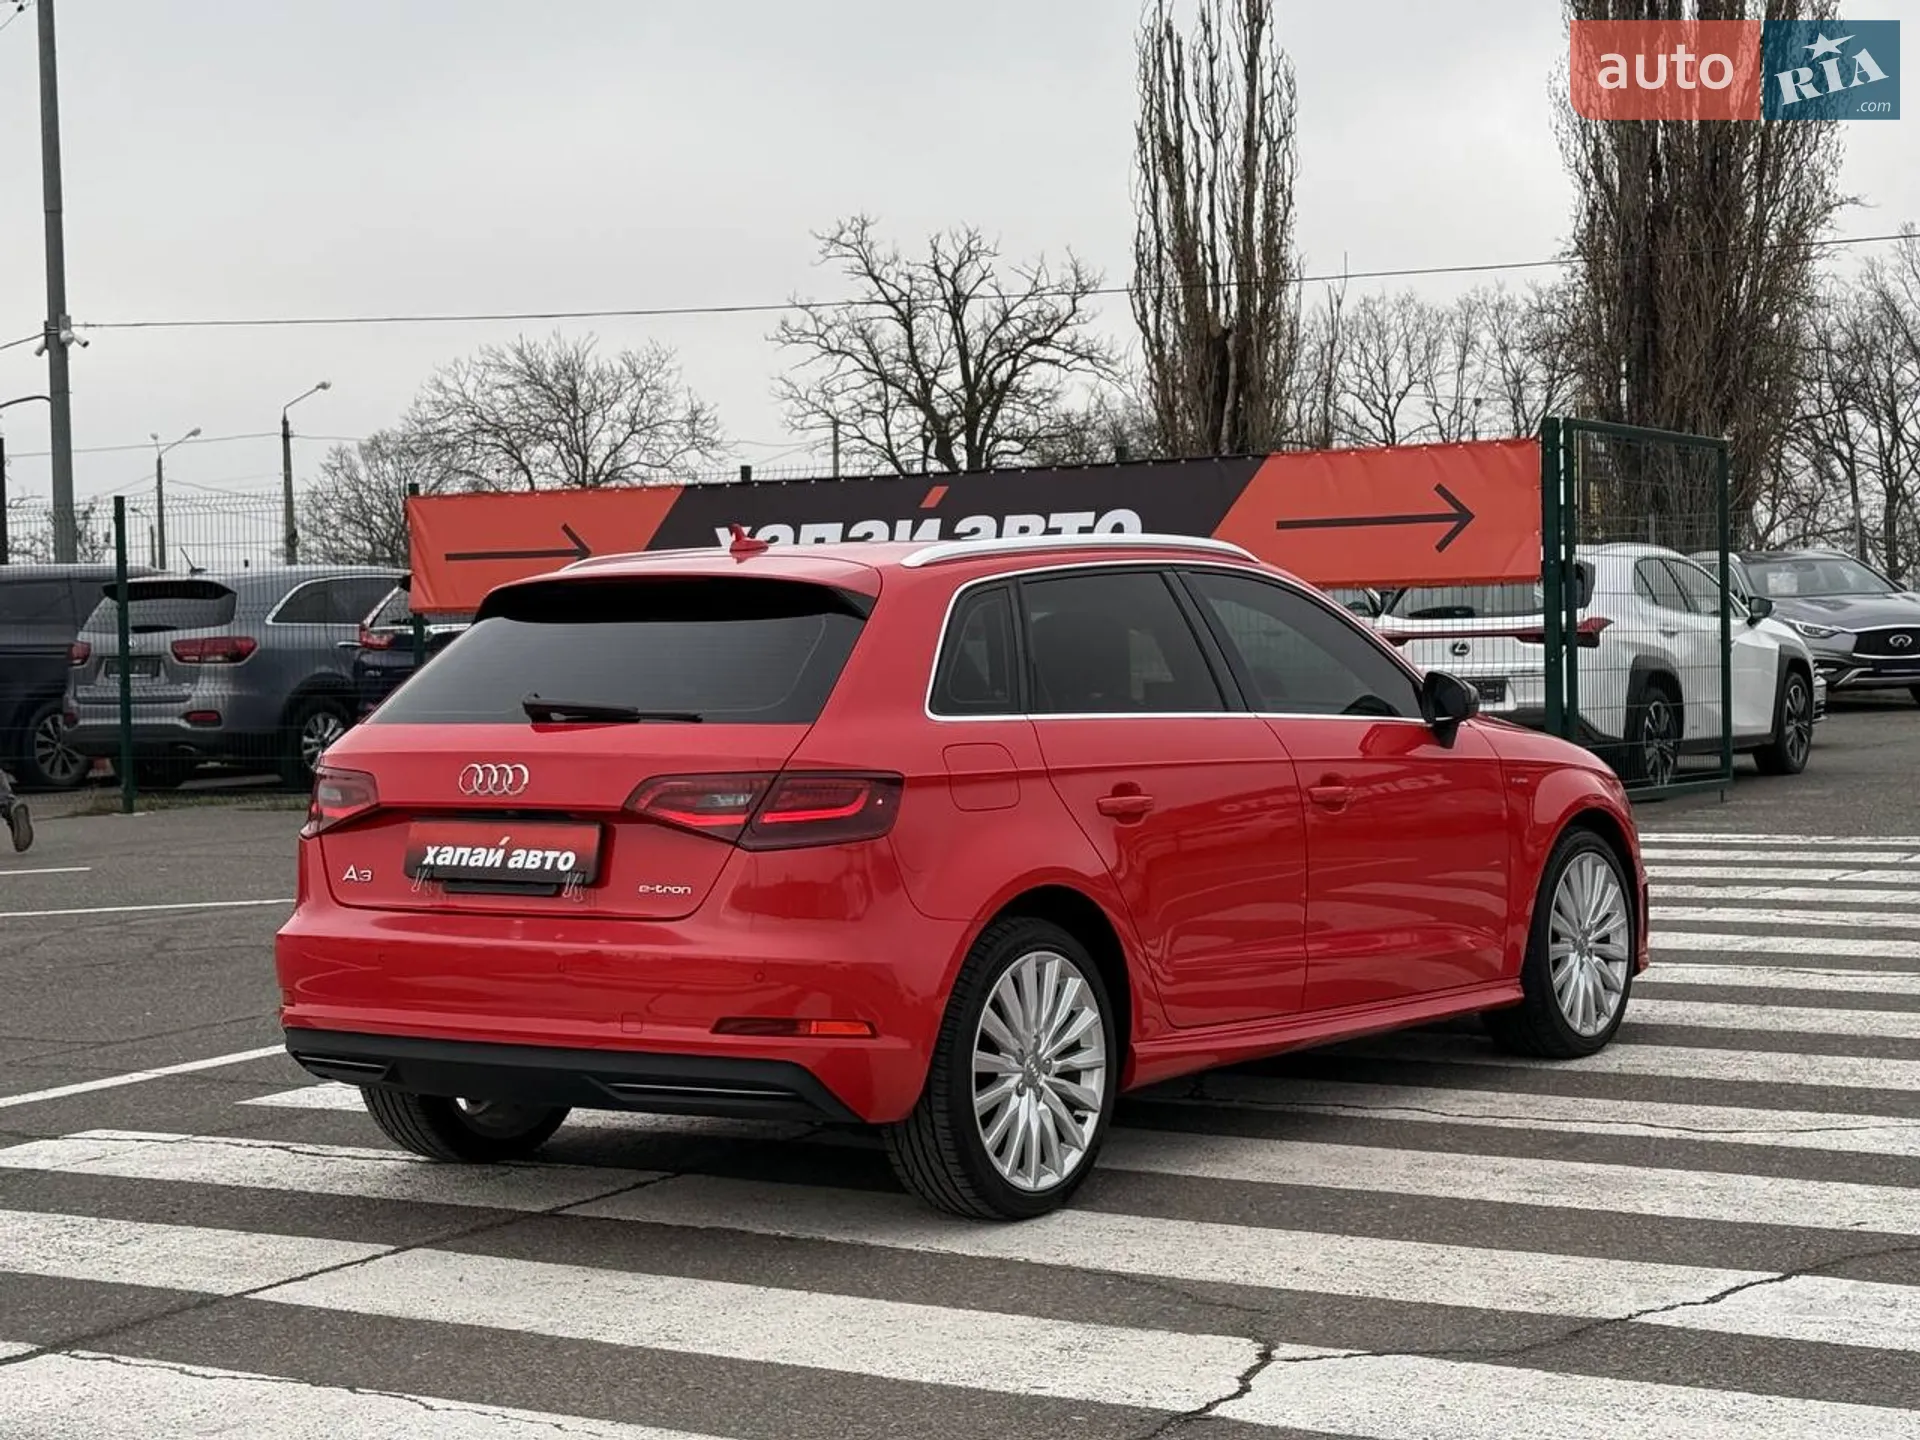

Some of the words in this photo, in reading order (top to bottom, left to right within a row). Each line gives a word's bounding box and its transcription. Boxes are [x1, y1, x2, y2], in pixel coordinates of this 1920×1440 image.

[422, 836, 511, 868] хапай
[507, 849, 577, 872] авто
[342, 864, 373, 882] A3
[638, 884, 692, 895] e-tron
